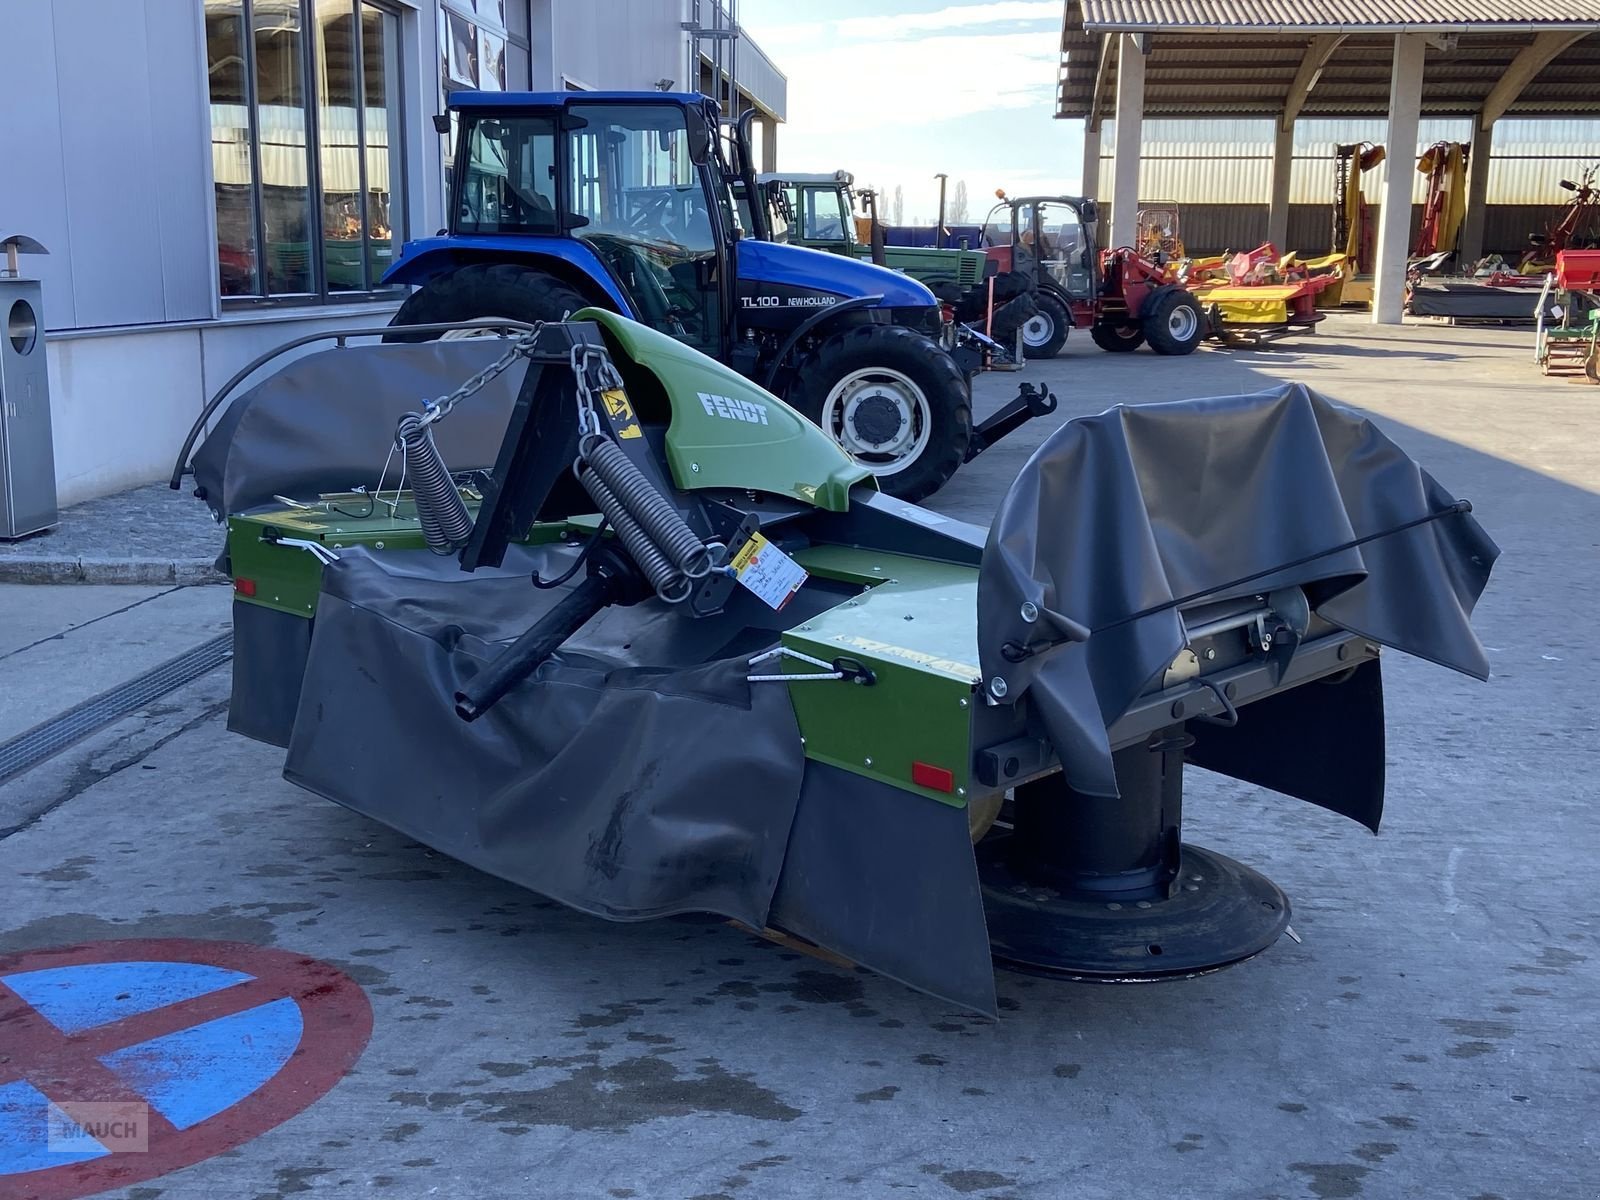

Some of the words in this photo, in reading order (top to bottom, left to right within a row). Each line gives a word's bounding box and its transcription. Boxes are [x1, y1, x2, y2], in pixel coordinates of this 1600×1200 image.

[741, 296, 780, 307] TL100
[787, 297, 804, 306] NEW
[803, 296, 836, 305] HOLLAND
[696, 392, 769, 425] FENDT
